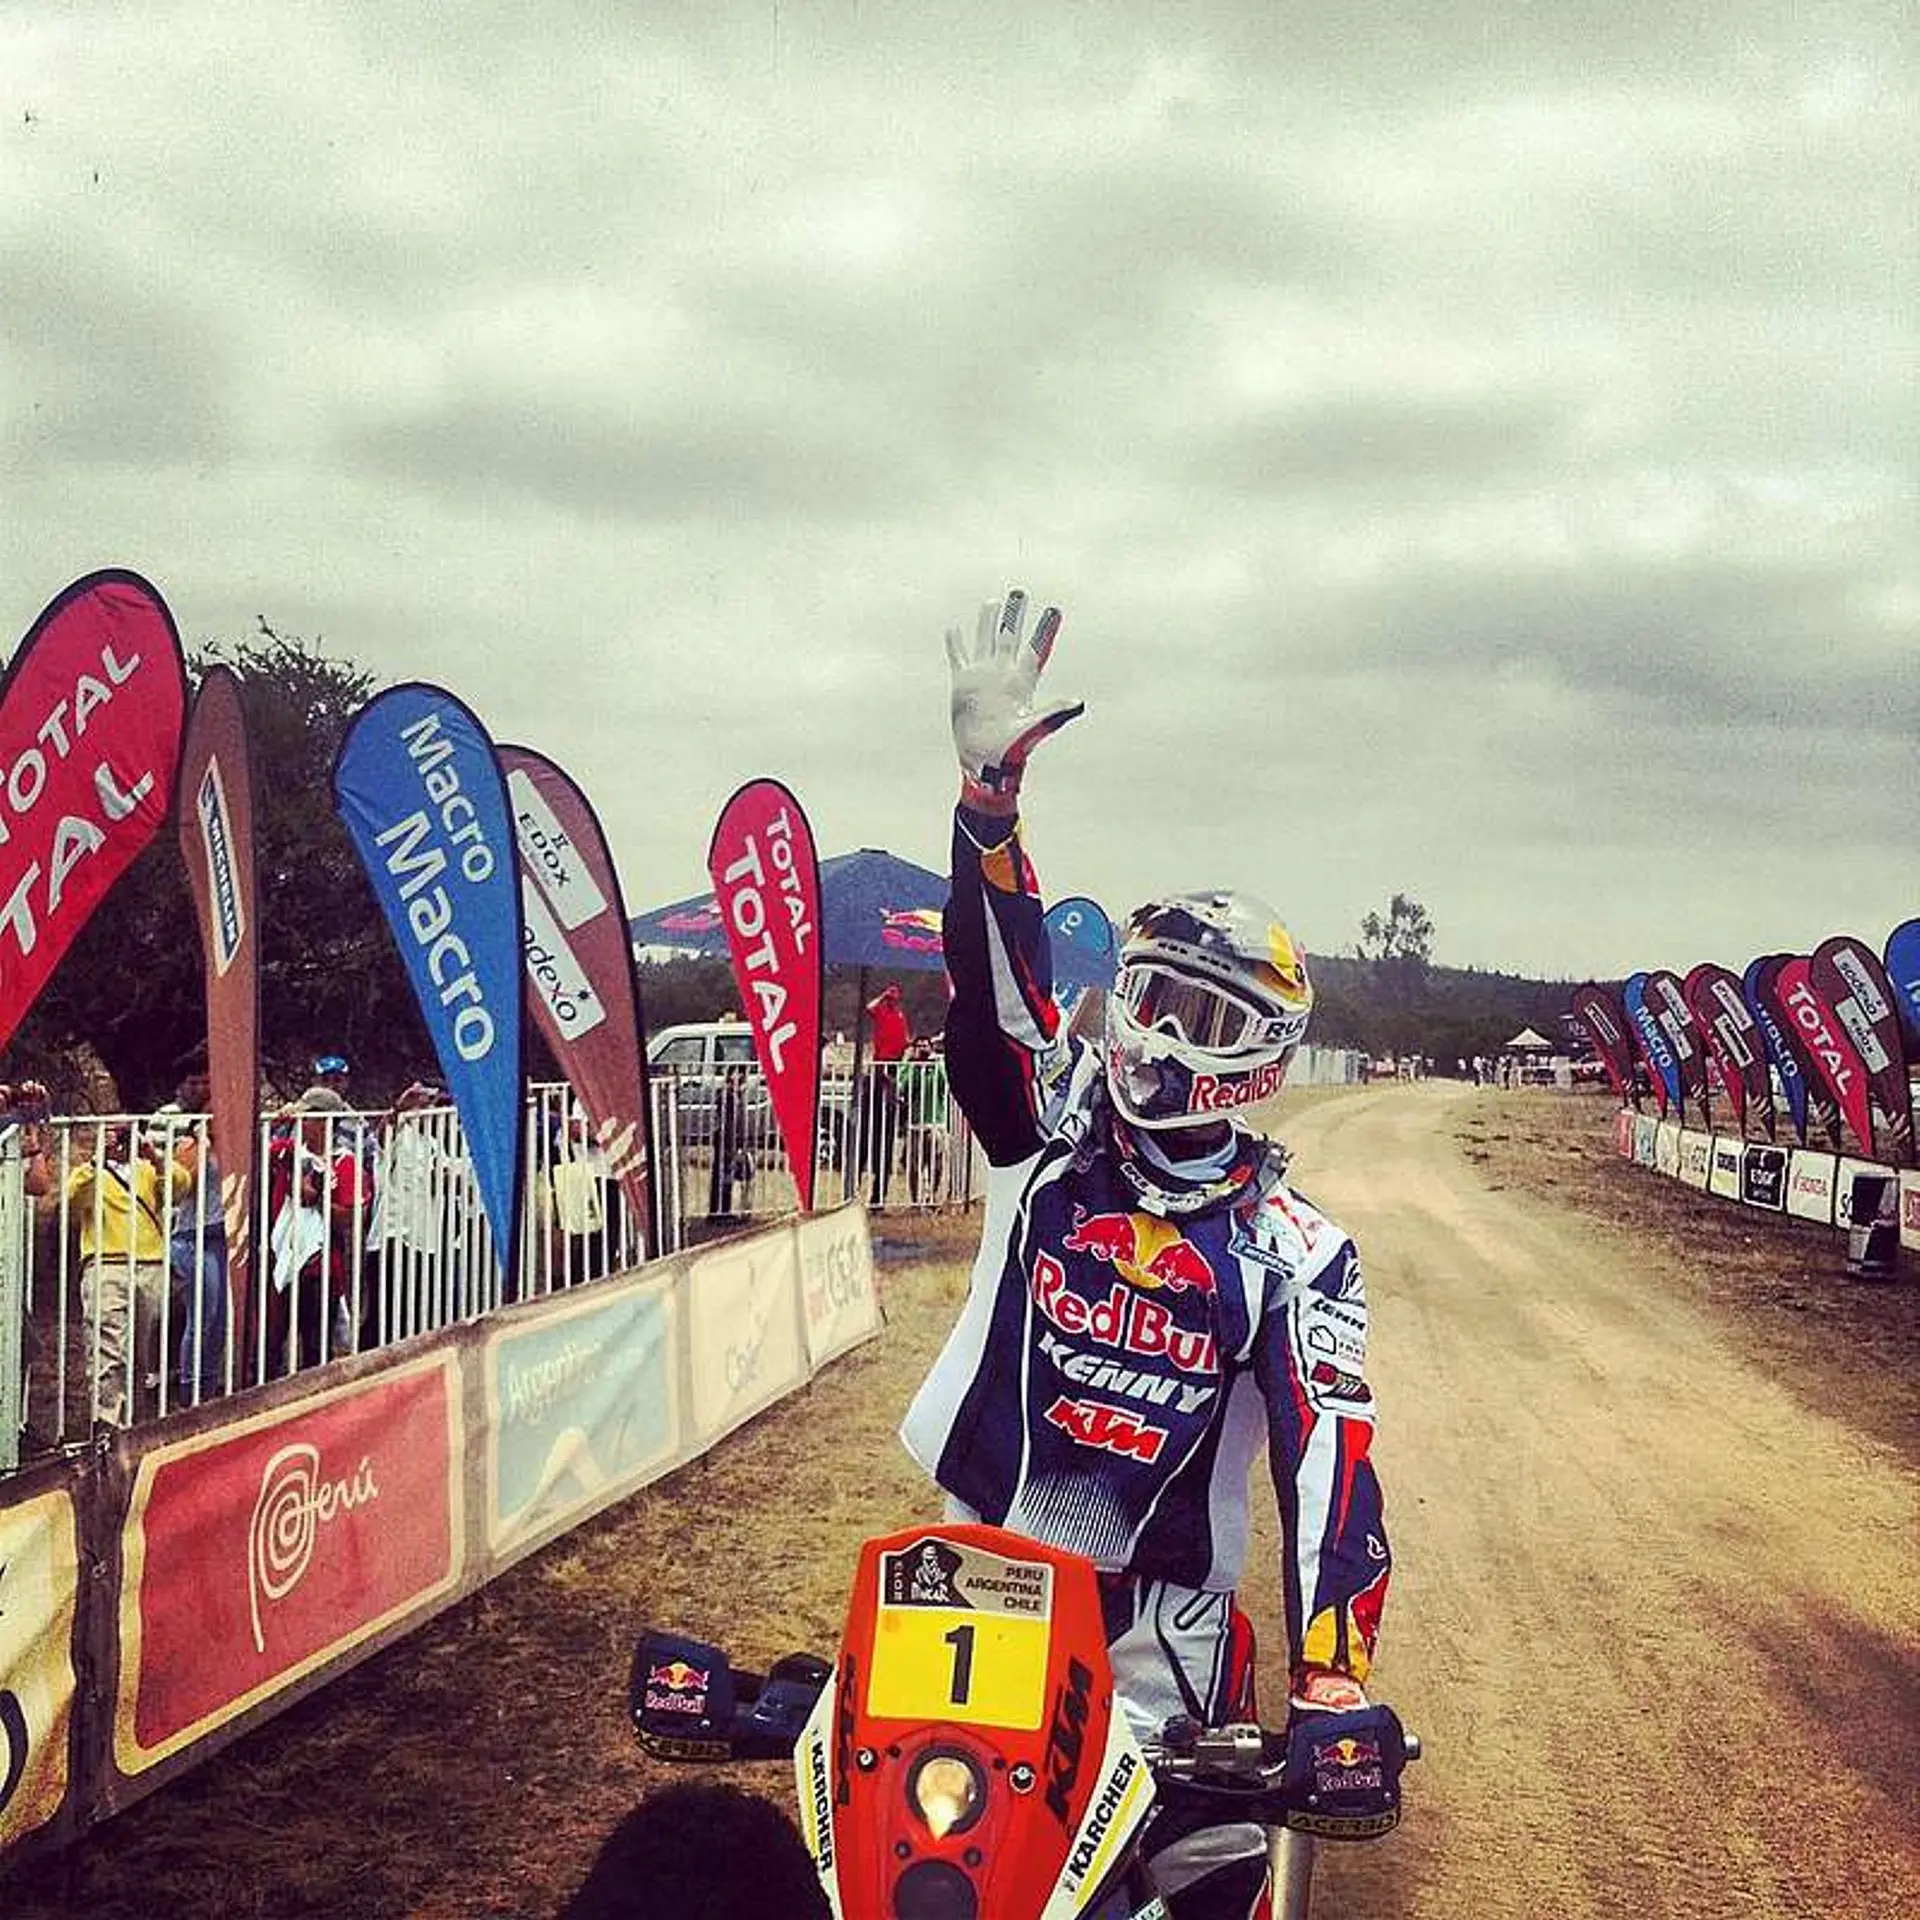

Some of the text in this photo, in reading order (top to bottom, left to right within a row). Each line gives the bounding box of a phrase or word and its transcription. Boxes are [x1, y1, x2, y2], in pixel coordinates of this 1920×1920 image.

[0, 645, 141, 845] OTAL
[402, 713, 496, 883] Macro
[0, 760, 154, 956] TAL
[519, 813, 570, 886] EDOX
[766, 808, 814, 955] TOTAL
[375, 810, 496, 1062] Macro
[723, 835, 798, 1075] TOTAL
[1265, 1018, 1304, 1039] RU
[1788, 981, 1852, 1095] TOTAL
[1033, 1249, 1129, 1346] Red
[1038, 1331, 1216, 1415] KENNY
[1043, 1395, 1169, 1465] KTM
[966, 1577, 1043, 1596] ARGENTINA
[1004, 1596, 1041, 1612] CHILE
[1005, 1567, 1044, 1581] PERU
[945, 1625, 976, 1705] 1
[1045, 1657, 1094, 1824] KTM
